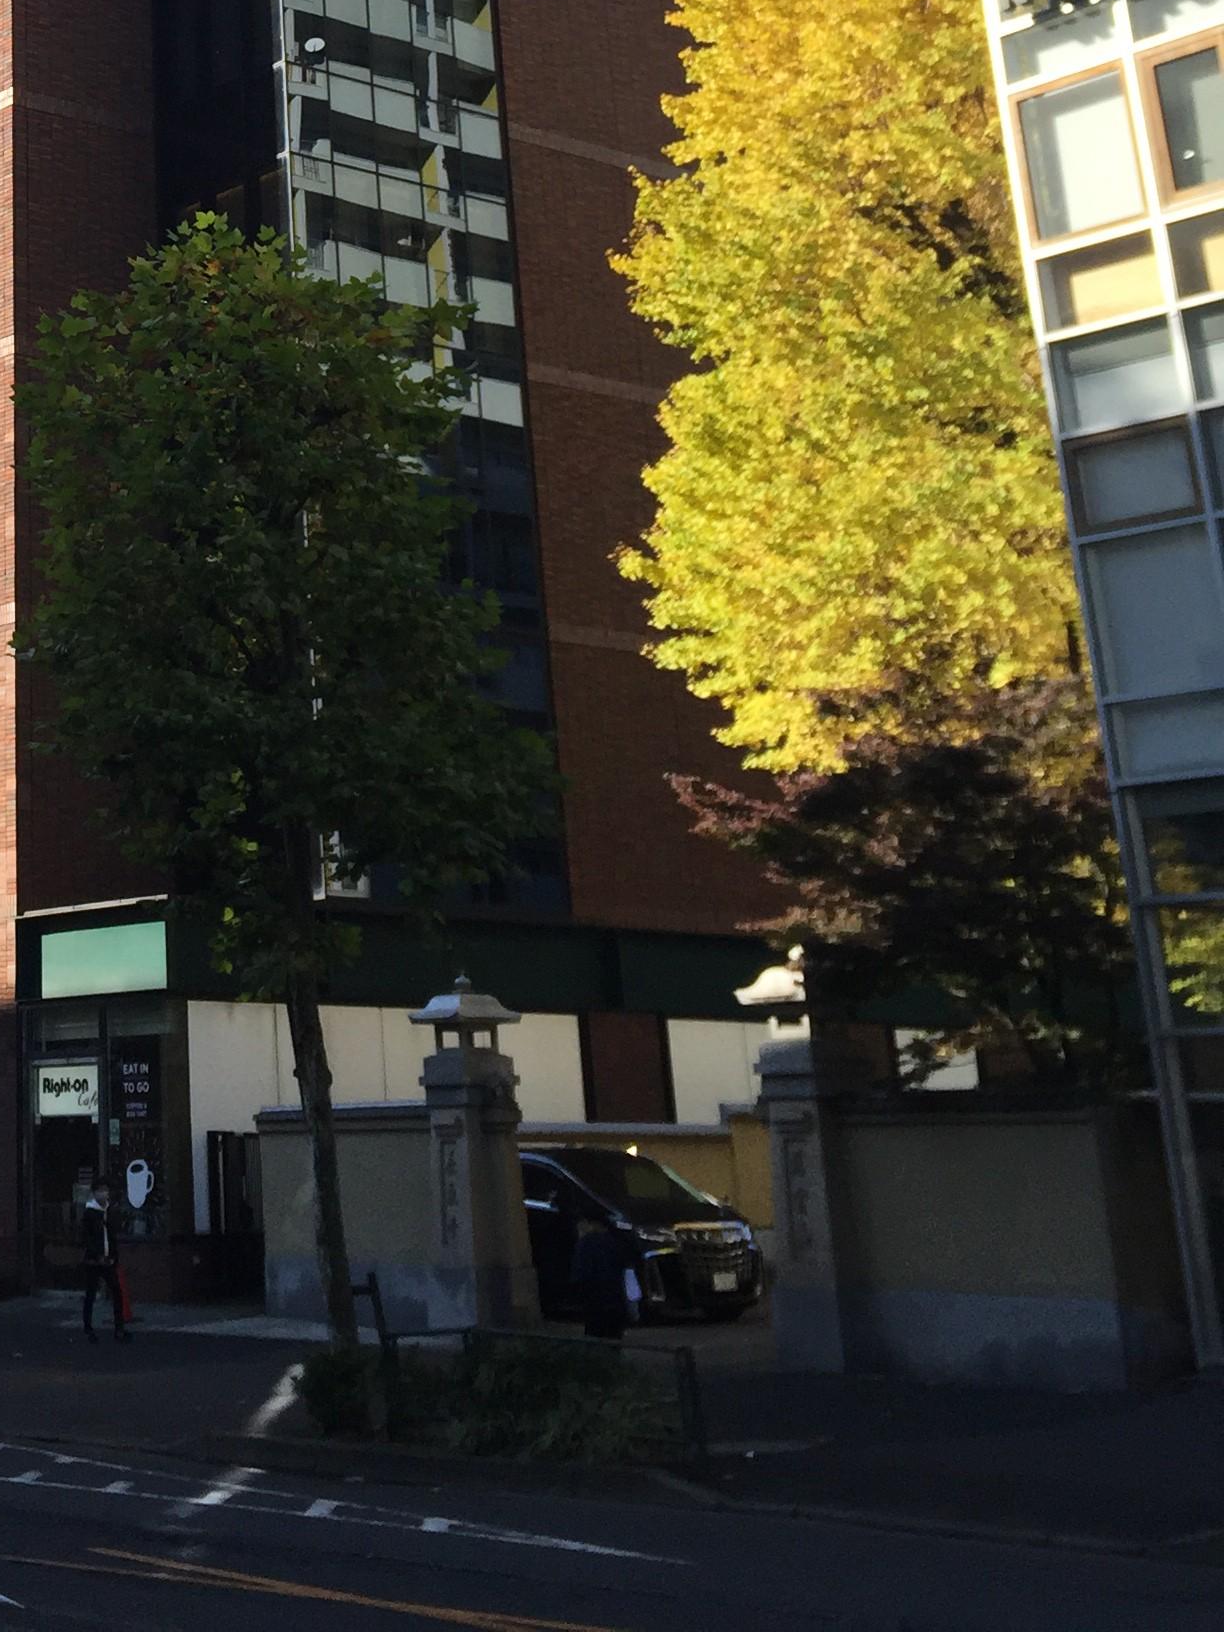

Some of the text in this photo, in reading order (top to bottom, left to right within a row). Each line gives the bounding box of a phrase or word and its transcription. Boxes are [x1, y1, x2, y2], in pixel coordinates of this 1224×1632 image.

[123, 1063, 149, 1075] EAT IN
[43, 1077, 89, 1098] Right-on
[123, 1081, 150, 1094] TO GO
